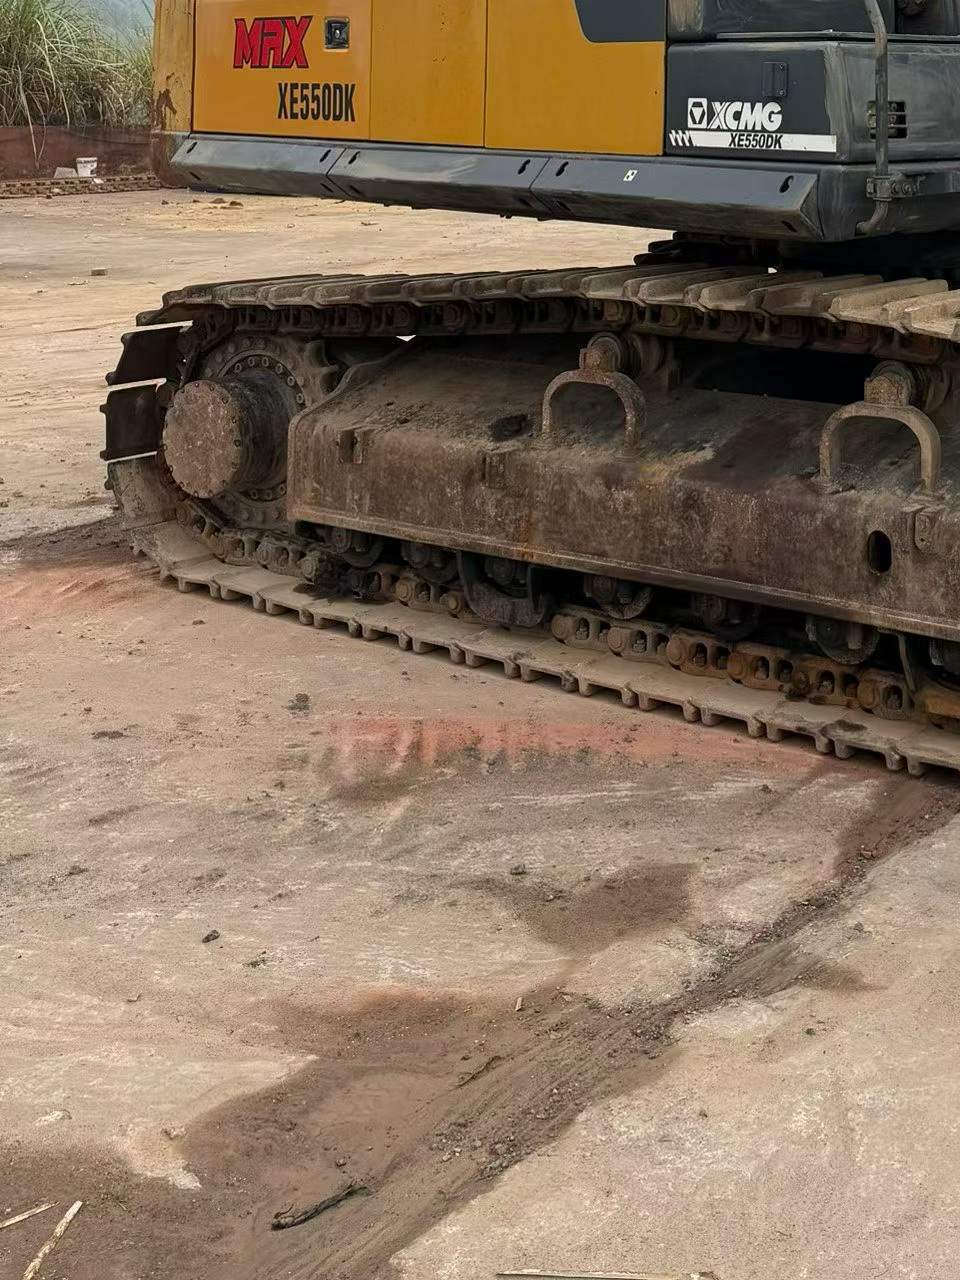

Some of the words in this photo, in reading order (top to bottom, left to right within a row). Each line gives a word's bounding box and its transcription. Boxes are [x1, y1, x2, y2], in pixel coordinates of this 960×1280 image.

[233, 16, 313, 68] MAX
[278, 83, 356, 122] XE550DK
[707, 102, 782, 131] XCMG
[729, 133, 783, 149] XE550DK
